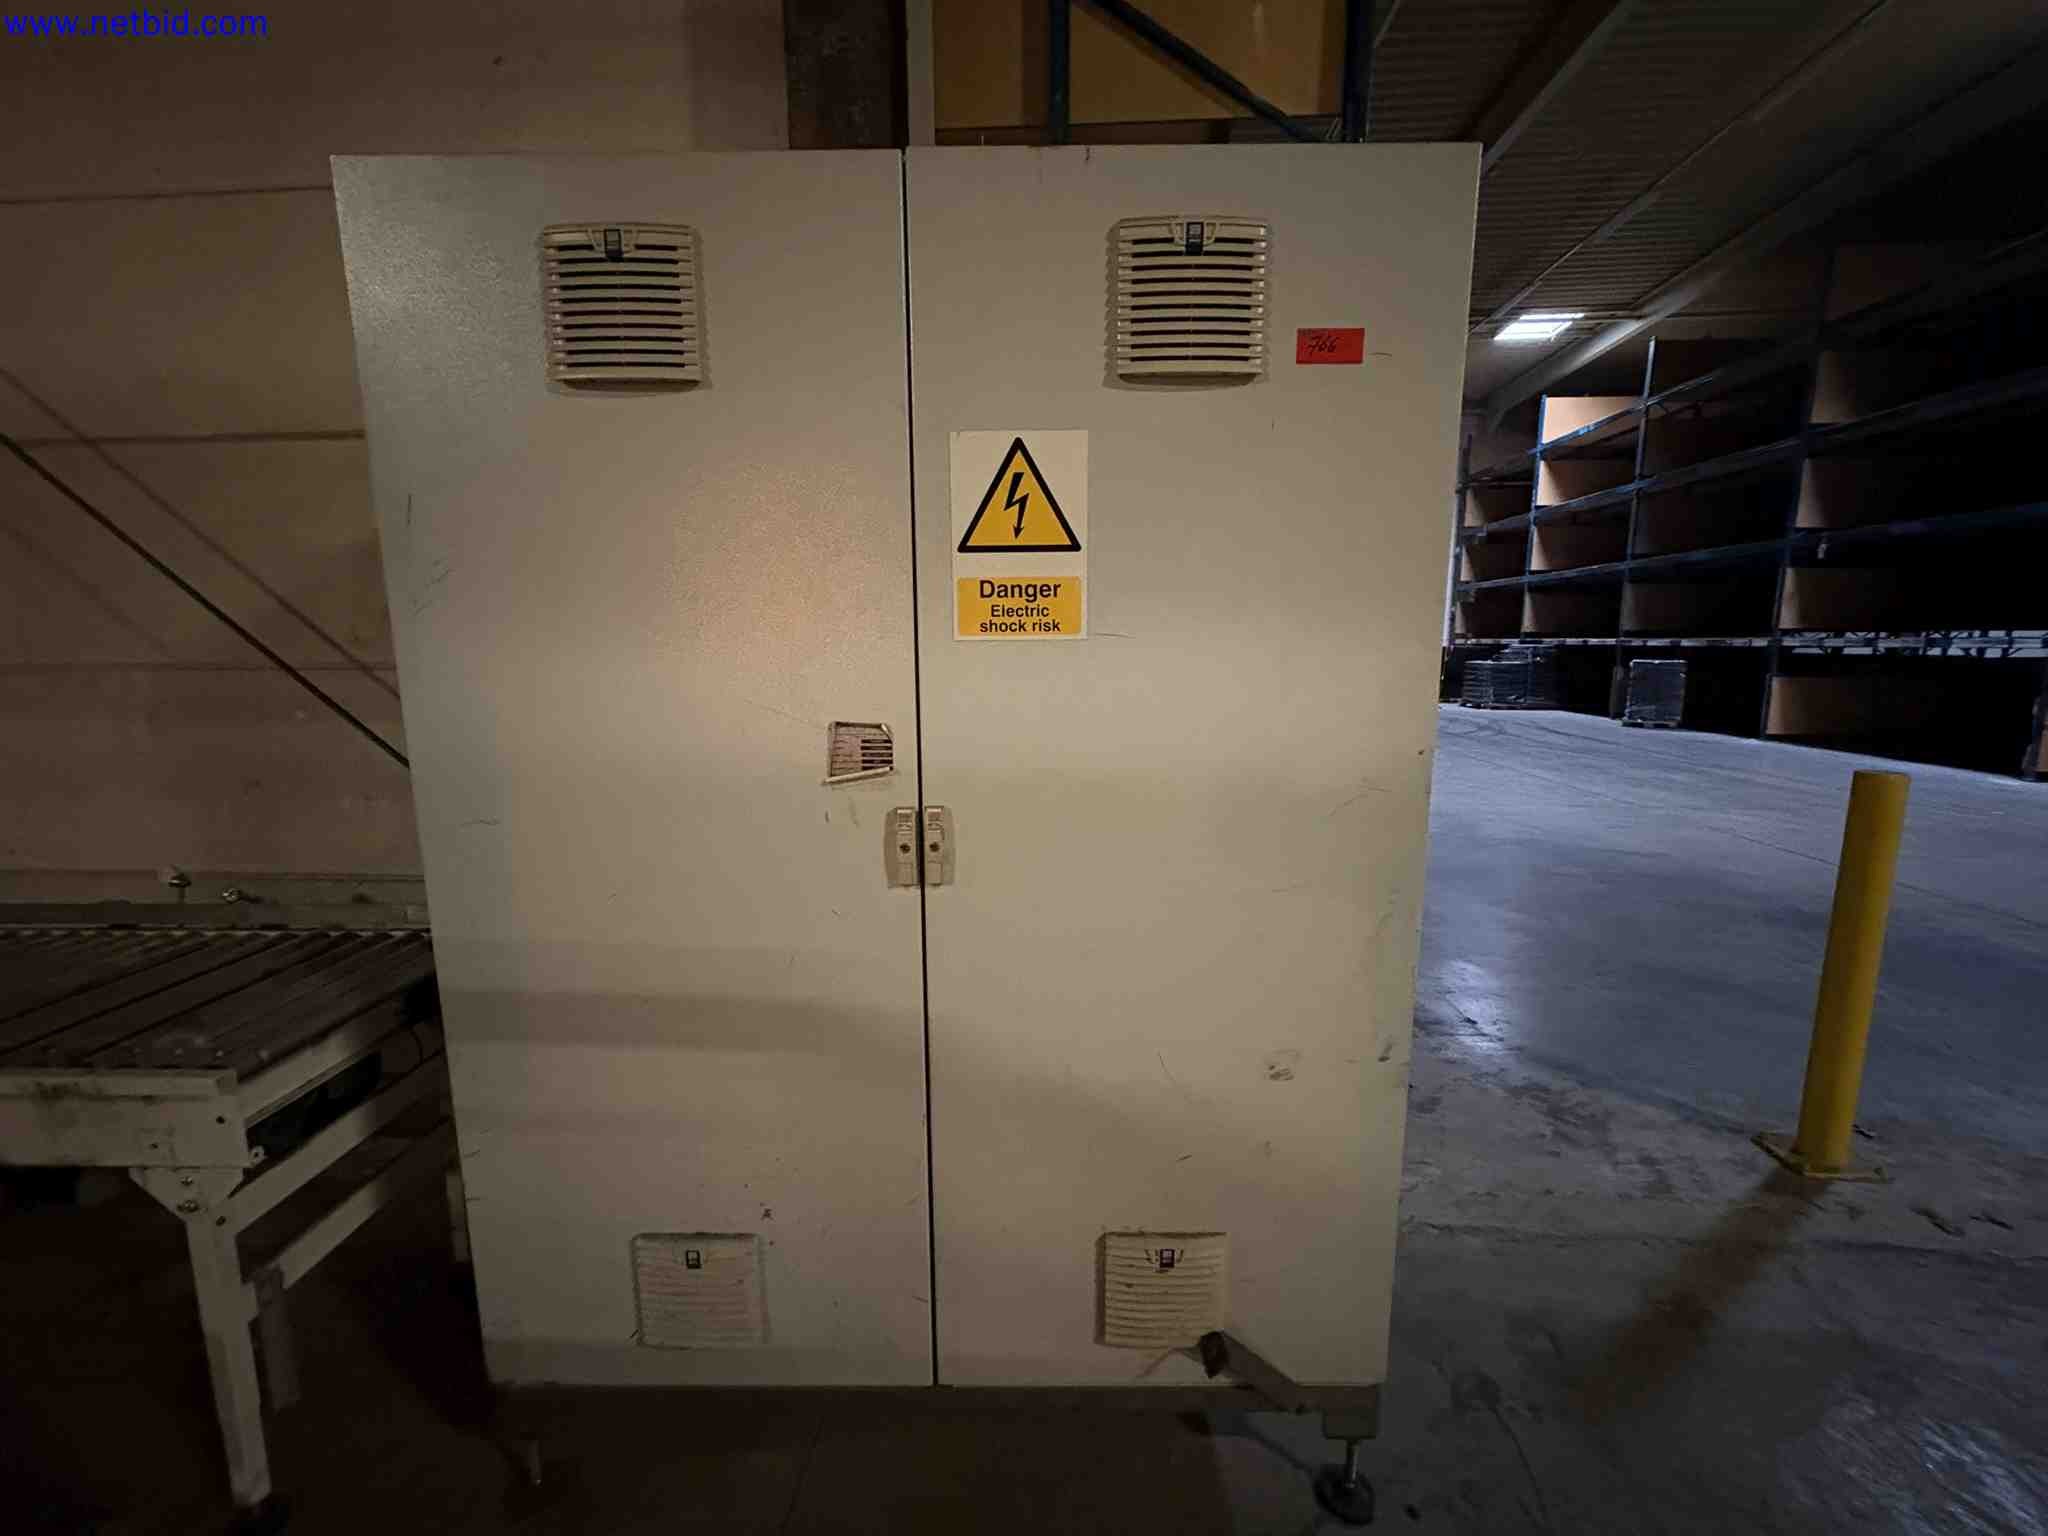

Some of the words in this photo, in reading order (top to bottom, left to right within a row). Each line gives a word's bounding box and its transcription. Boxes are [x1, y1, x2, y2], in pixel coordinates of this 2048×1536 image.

[979, 580, 1061, 603] Danger
[991, 604, 1050, 618] Electric
[979, 619, 1027, 633] shock
[1032, 619, 1061, 633] risk
